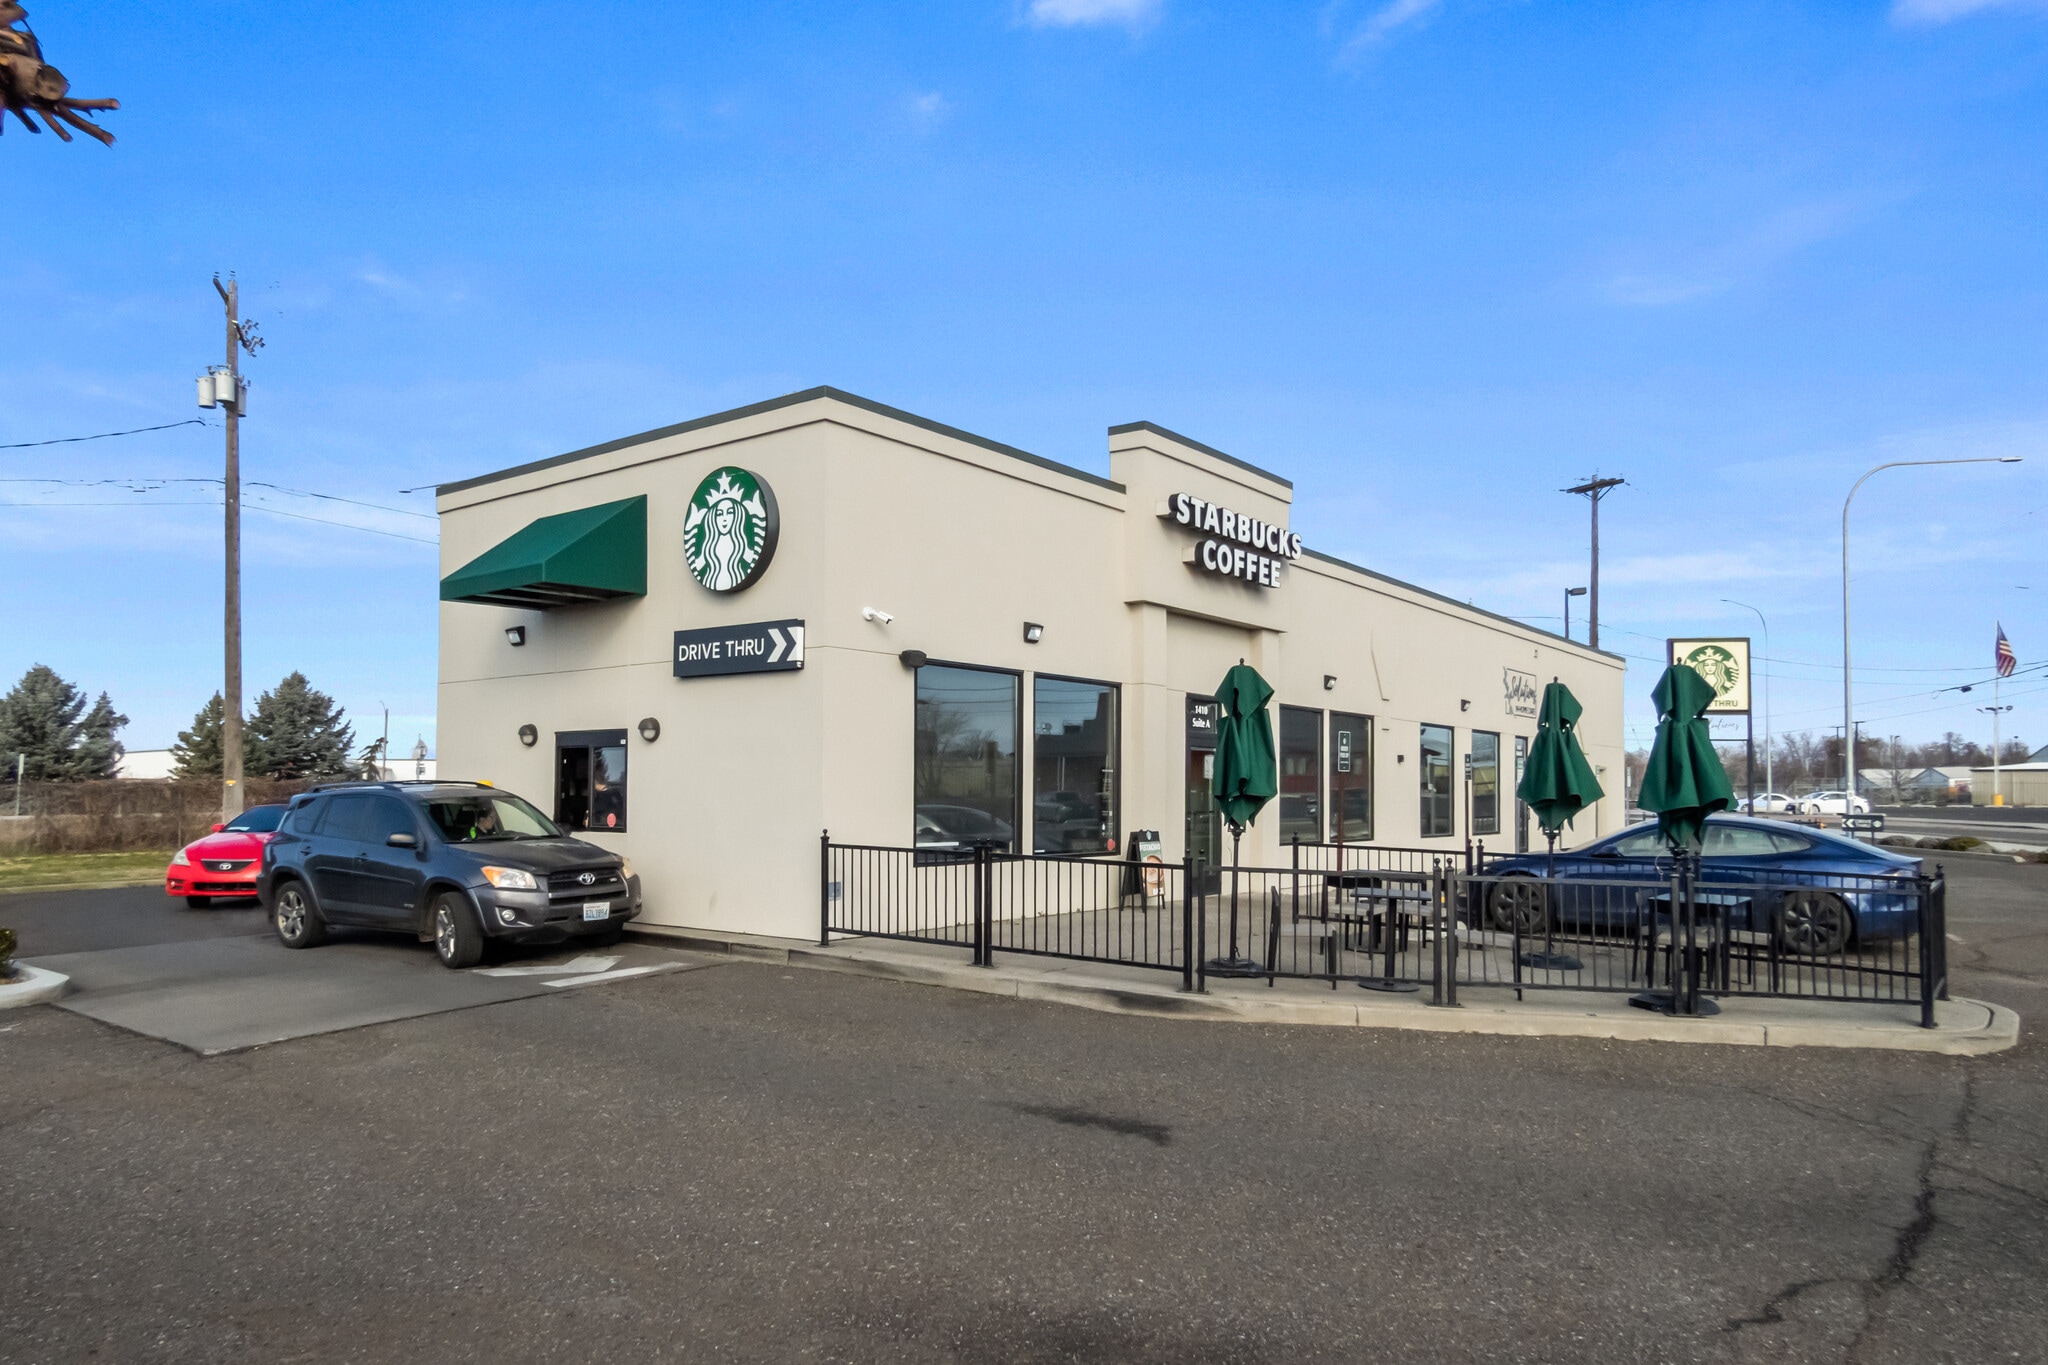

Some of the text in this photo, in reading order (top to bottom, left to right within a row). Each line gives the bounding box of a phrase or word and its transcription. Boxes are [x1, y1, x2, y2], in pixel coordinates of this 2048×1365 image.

[1175, 492, 1302, 560] STARBUCKS
[1202, 539, 1282, 588] COFFEE
[678, 638, 764, 662] DRIVE THRU
[1194, 704, 1209, 715] 1410
[1192, 717, 1211, 729] Suite A
